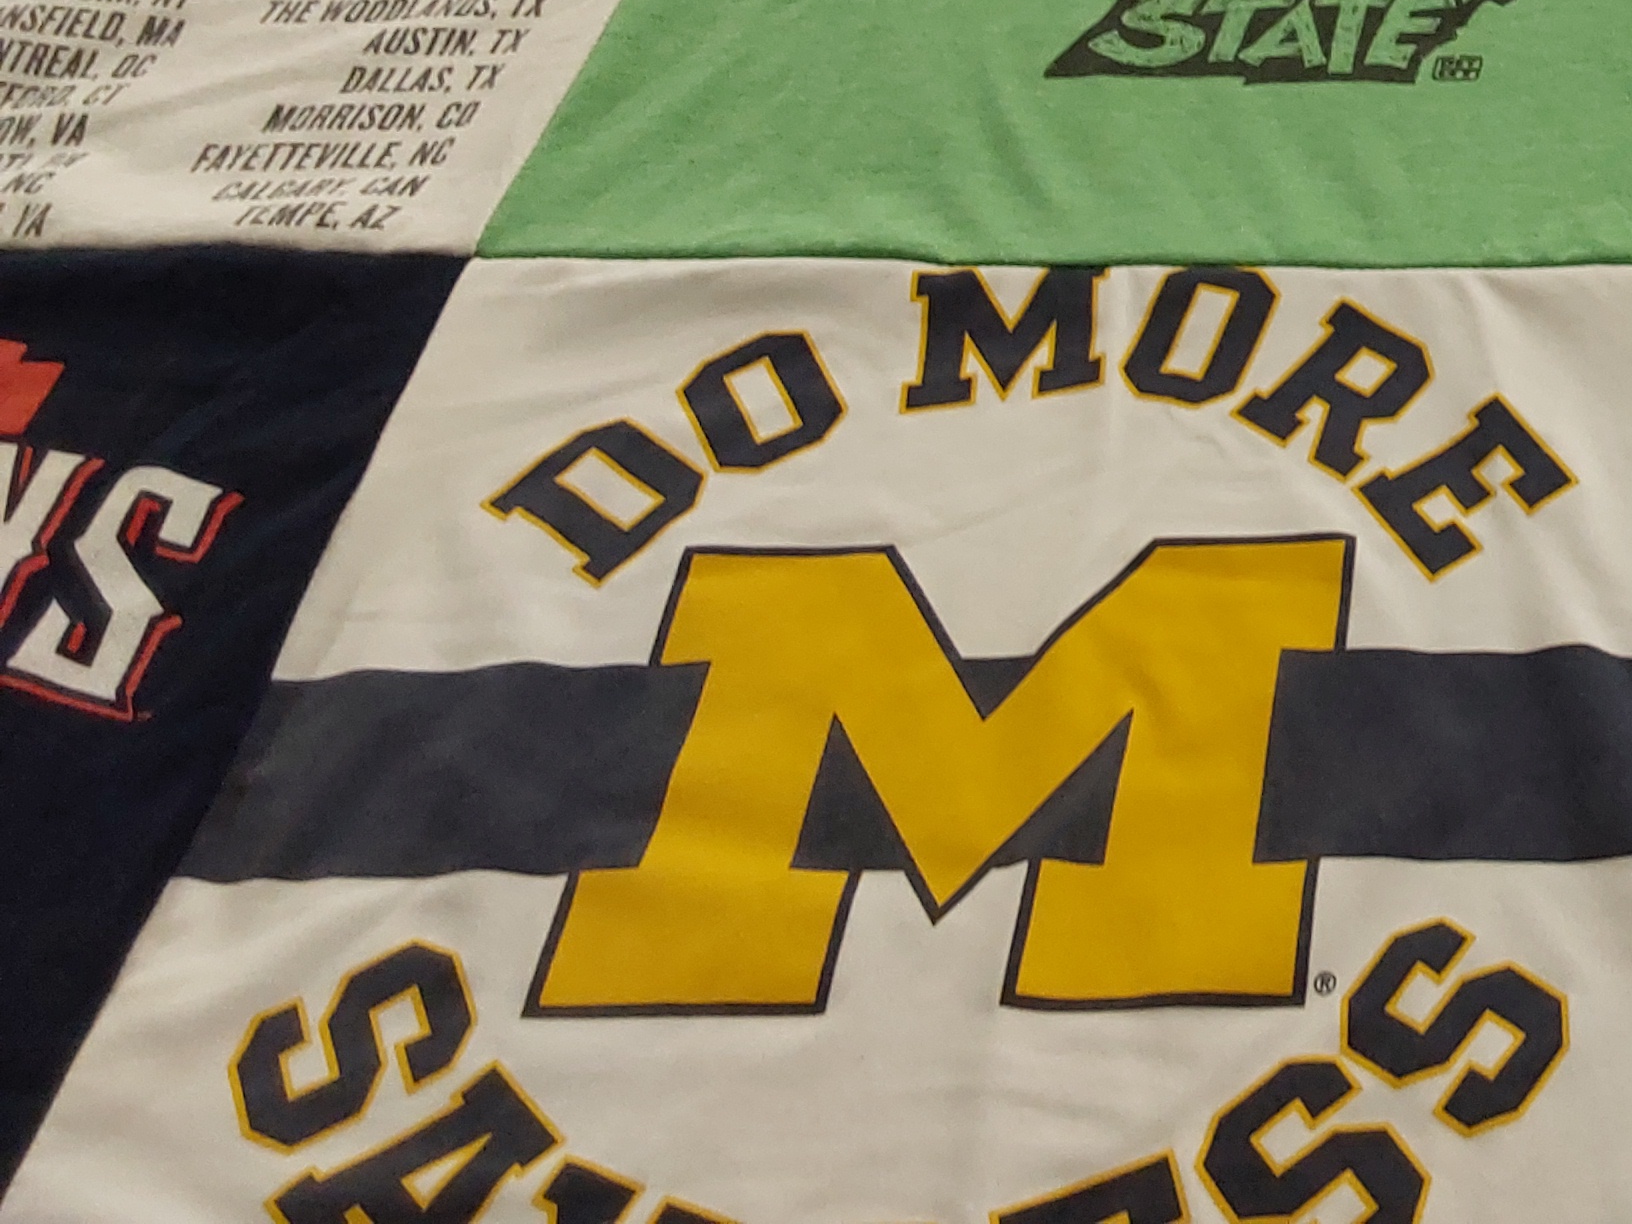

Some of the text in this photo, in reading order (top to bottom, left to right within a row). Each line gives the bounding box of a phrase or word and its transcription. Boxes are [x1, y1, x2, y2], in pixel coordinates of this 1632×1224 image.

[0, 3, 187, 48] NSFIELD, MA
[260, 0, 319, 25] THE
[361, 27, 531, 57] AUSTIN, TX
[340, 63, 506, 95] DALLAS, TX
[51, 112, 89, 147] VA
[260, 100, 481, 135] MORRISON, CO
[190, 136, 457, 174] FAYETTEVILLE, NC
[359, 175, 433, 199] CAN
[234, 200, 404, 231] TEMPE, AZ
[480, 264, 1580, 589] DO MORE
[522, 533, 1357, 1020] M
